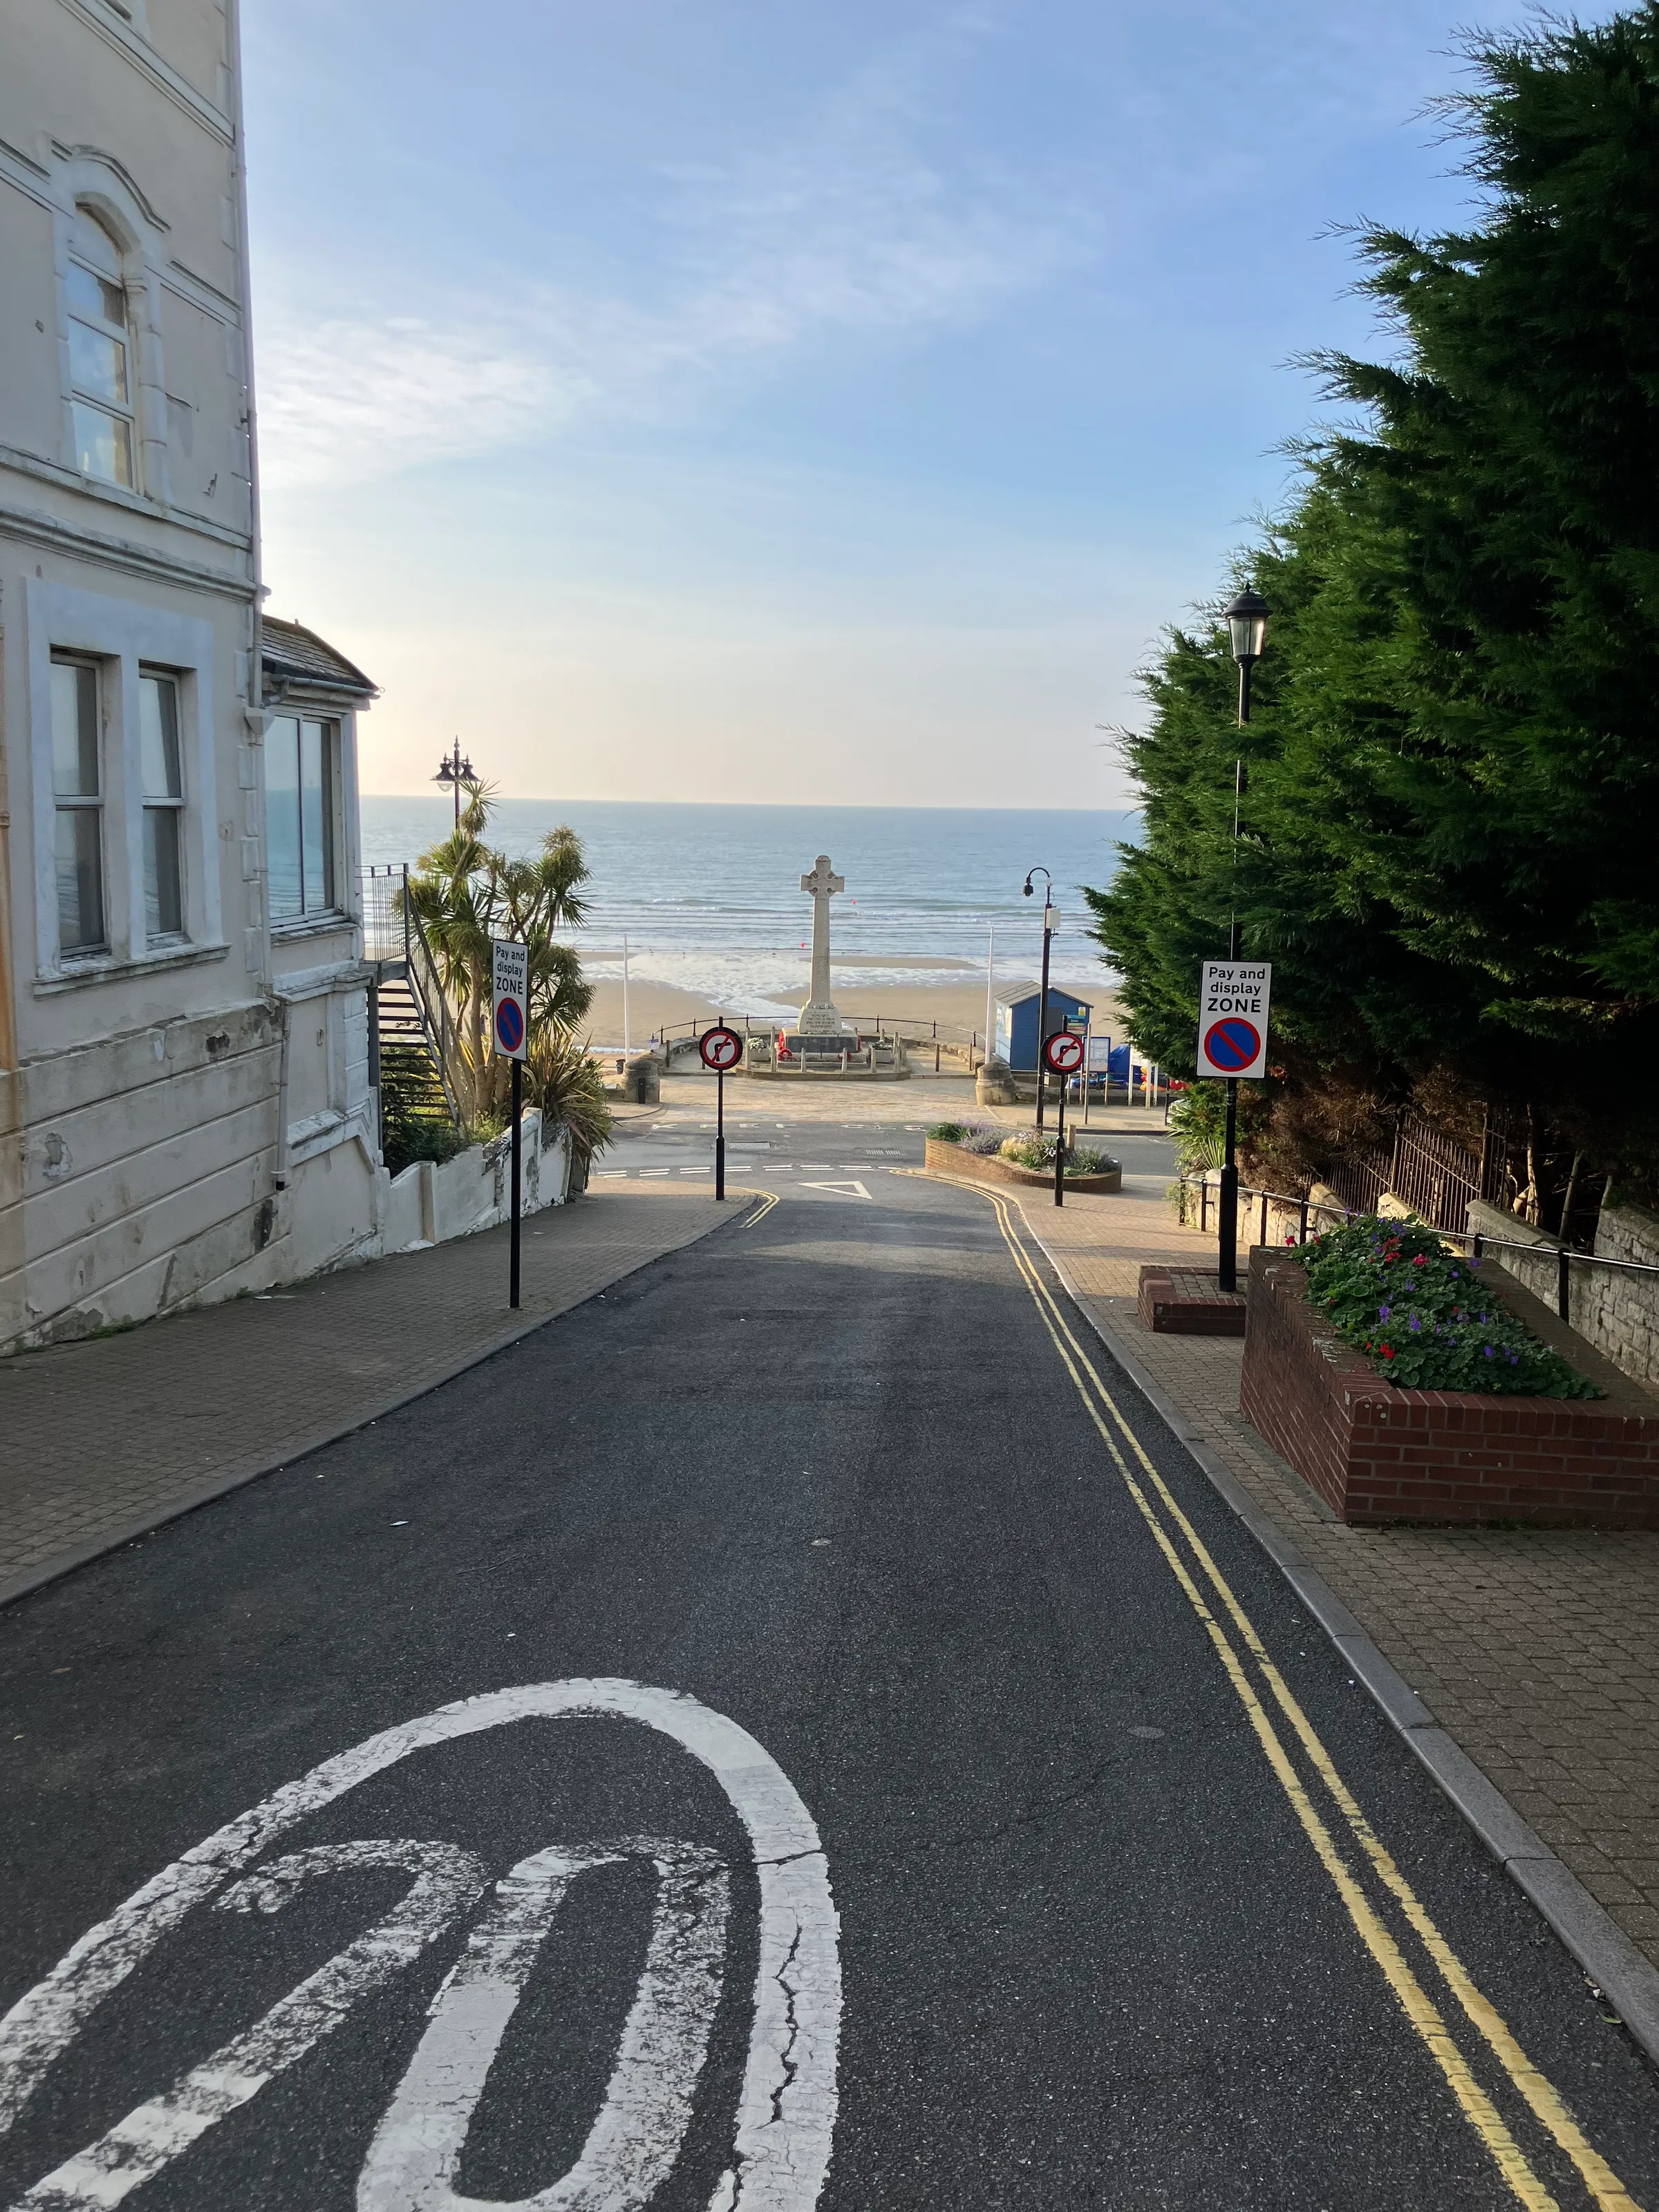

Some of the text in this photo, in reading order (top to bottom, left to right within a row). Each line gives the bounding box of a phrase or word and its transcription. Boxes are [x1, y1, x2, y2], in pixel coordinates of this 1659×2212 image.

[496, 945, 525, 962] Pay and
[497, 962, 523, 978] display
[1208, 966, 1266, 981] Pay and
[496, 976, 523, 995] ZONE
[1210, 981, 1262, 996] display
[1207, 997, 1262, 1013] ZONE
[10, 1836, 731, 2212] 20
